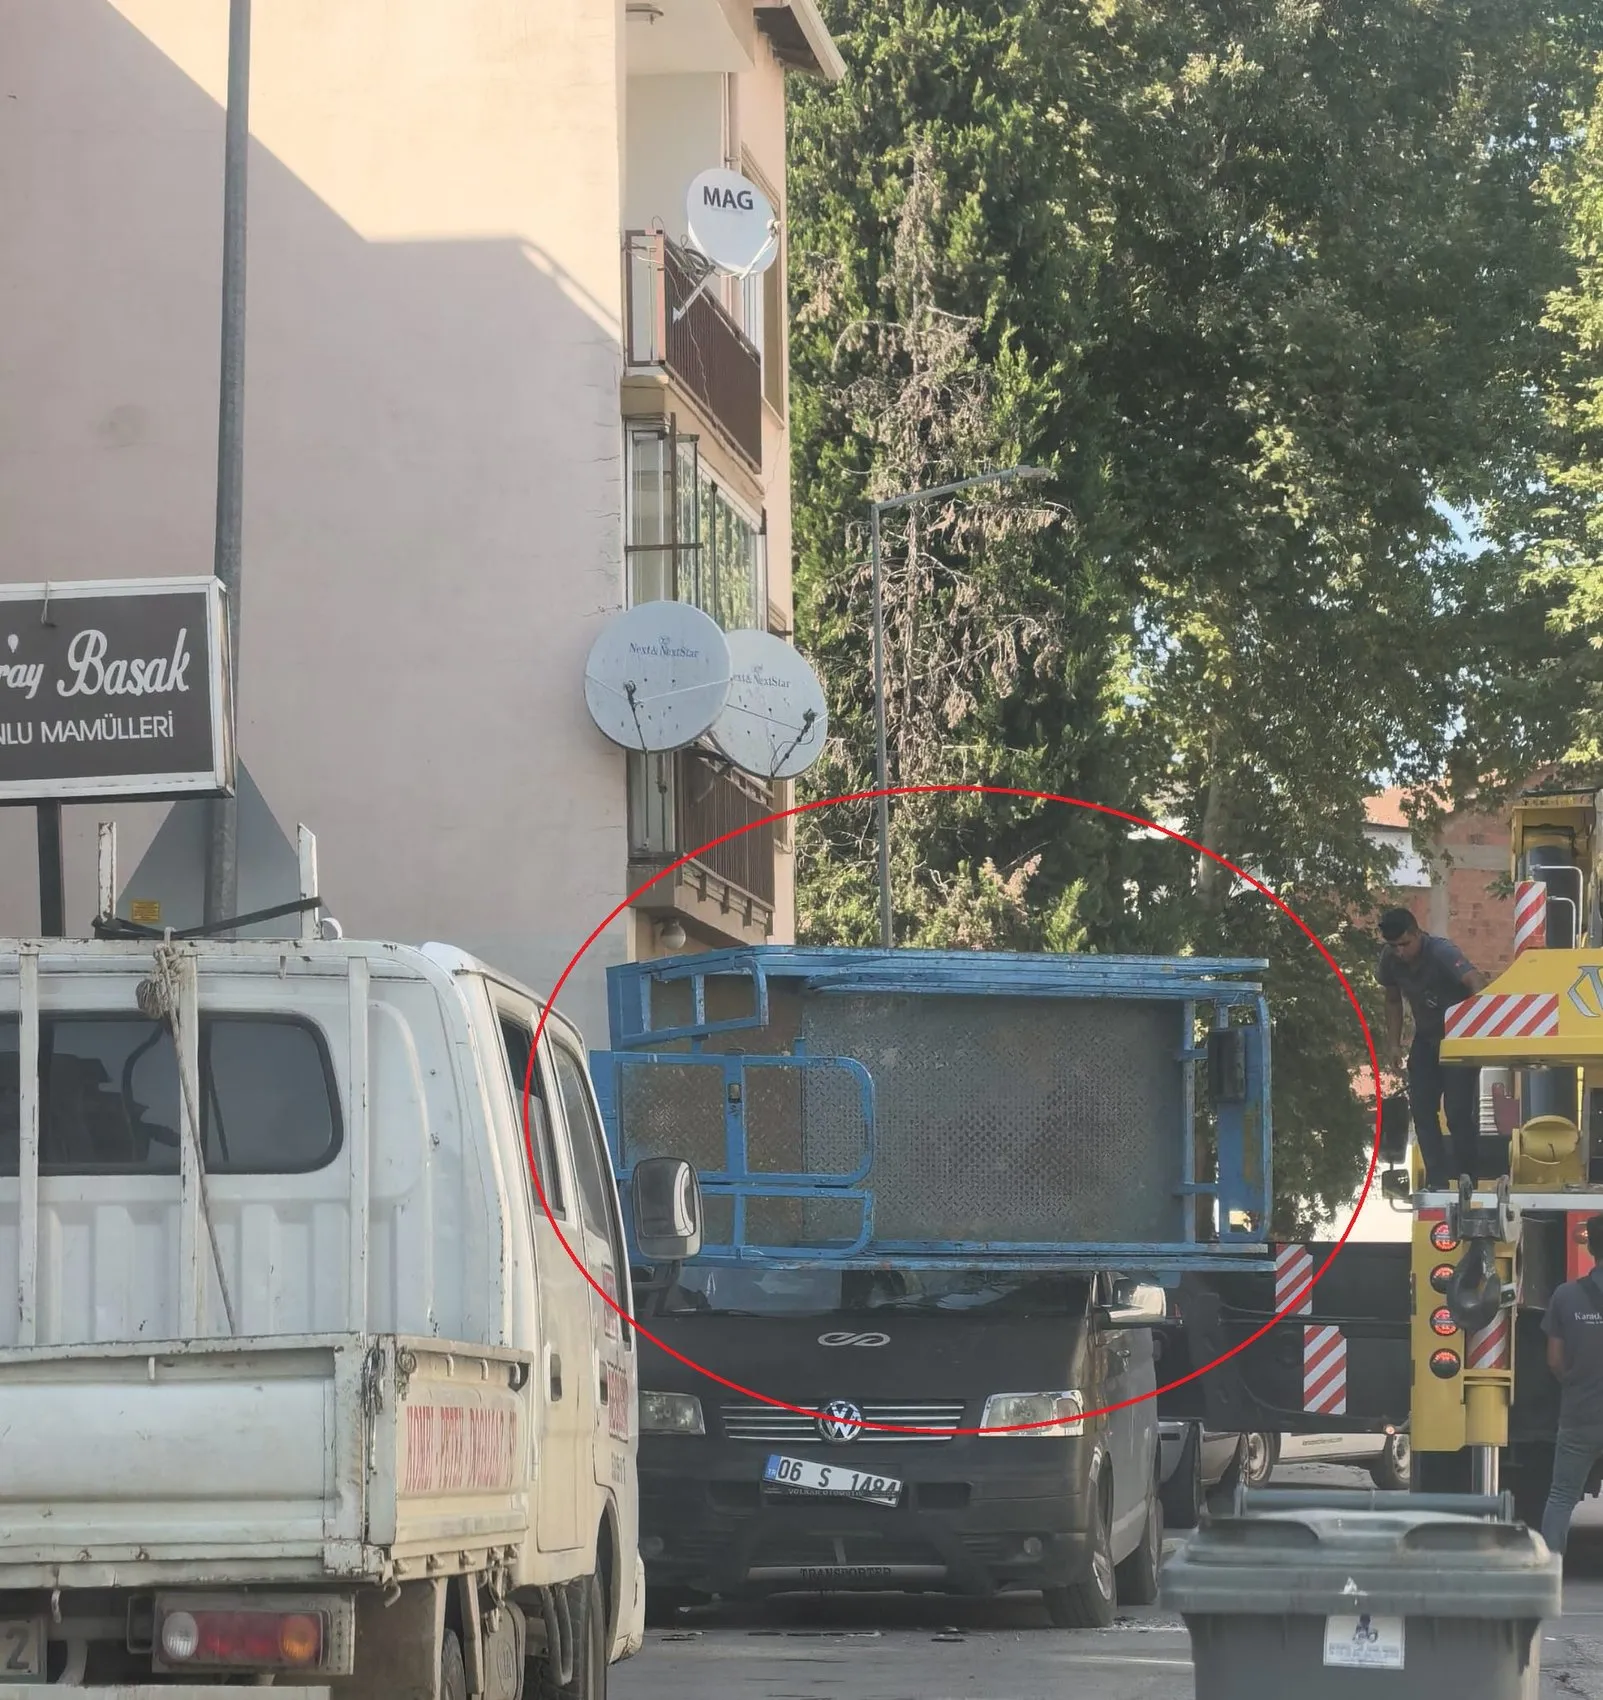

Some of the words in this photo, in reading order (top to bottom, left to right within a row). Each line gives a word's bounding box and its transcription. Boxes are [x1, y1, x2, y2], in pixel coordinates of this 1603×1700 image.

[703, 186, 754, 210] MAG
[41, 710, 173, 743] MAMÜLLERİ
[767, 1468, 777, 1476] TR
[778, 1459, 803, 1481] 06
[818, 1467, 832, 1488] S
[6, 1626, 30, 1670] 2
